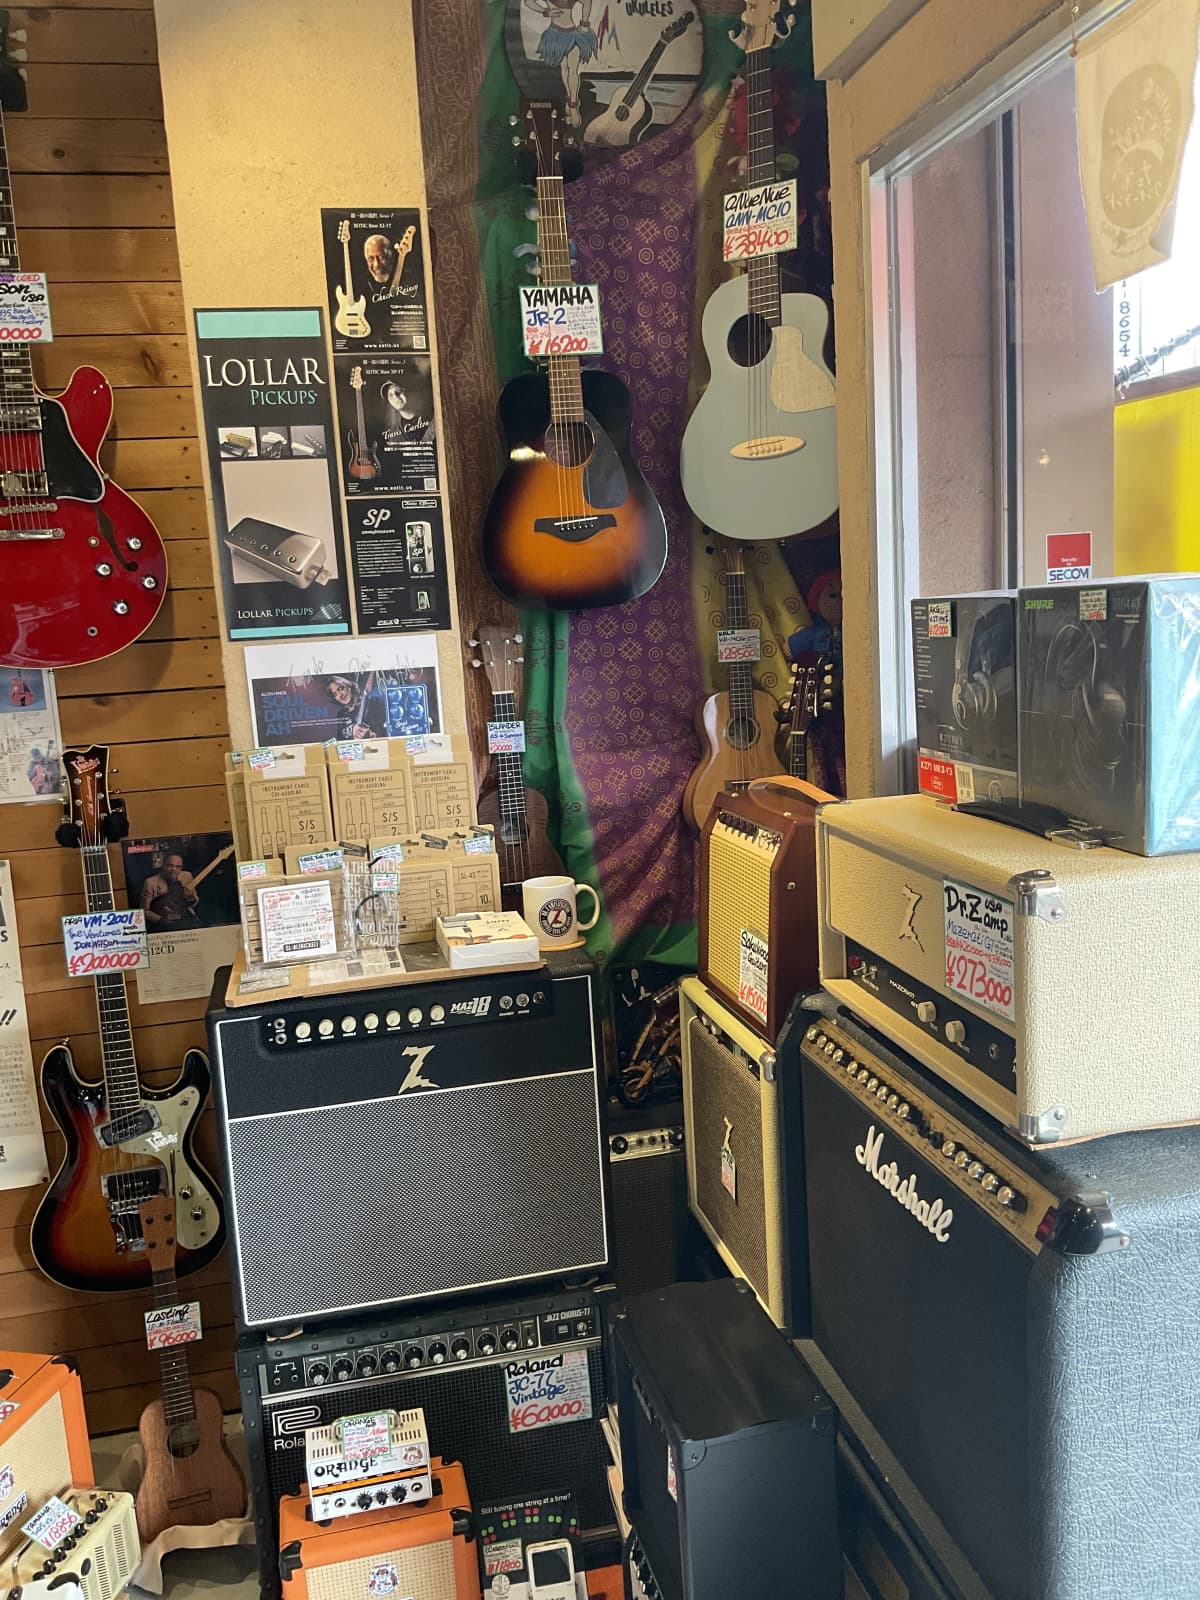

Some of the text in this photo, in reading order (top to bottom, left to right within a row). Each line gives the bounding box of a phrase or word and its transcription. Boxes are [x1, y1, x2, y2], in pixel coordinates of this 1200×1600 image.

[625, 0, 674, 17] UKULELES
[522, 286, 594, 308] YAMAHA
[526, 308, 567, 326] JR-2
[203, 355, 327, 386] LOLLAR
[250, 389, 317, 405] PICKUPS
[1049, 567, 1089, 581] SECOM
[237, 607, 315, 619] LOLLAR PICKUPS
[1024, 599, 1055, 610] SHURE
[264, 705, 330, 722] DRIVEN
[382, 812, 399, 823] S/S
[446, 804, 462, 815] S/S
[298, 820, 316, 831] S/S
[479, 894, 489, 904] 10
[985, 898, 1003, 913] USA
[83, 911, 135, 928] VM-2001
[944, 886, 1008, 938] Dr.Z amp
[855, 1125, 954, 1243] Marshall
[545, 1307, 591, 1322] JAZZ CHORUS-77
[505, 1354, 564, 1379] Roland
[508, 1370, 555, 1395] JC-77
[511, 1384, 569, 1406] Vintage
[344, 1416, 376, 1428] ORANGE
[273, 1436, 305, 1451] Rola
[314, 1457, 379, 1478] ORANGE
[0, 1496, 27, 1528] RANGE
[481, 1507, 493, 1515] Still
[493, 1504, 512, 1513] tuning
[525, 1499, 543, 1507] string
[554, 1492, 571, 1502] time?
[25, 1505, 52, 1531] YAMAHA
